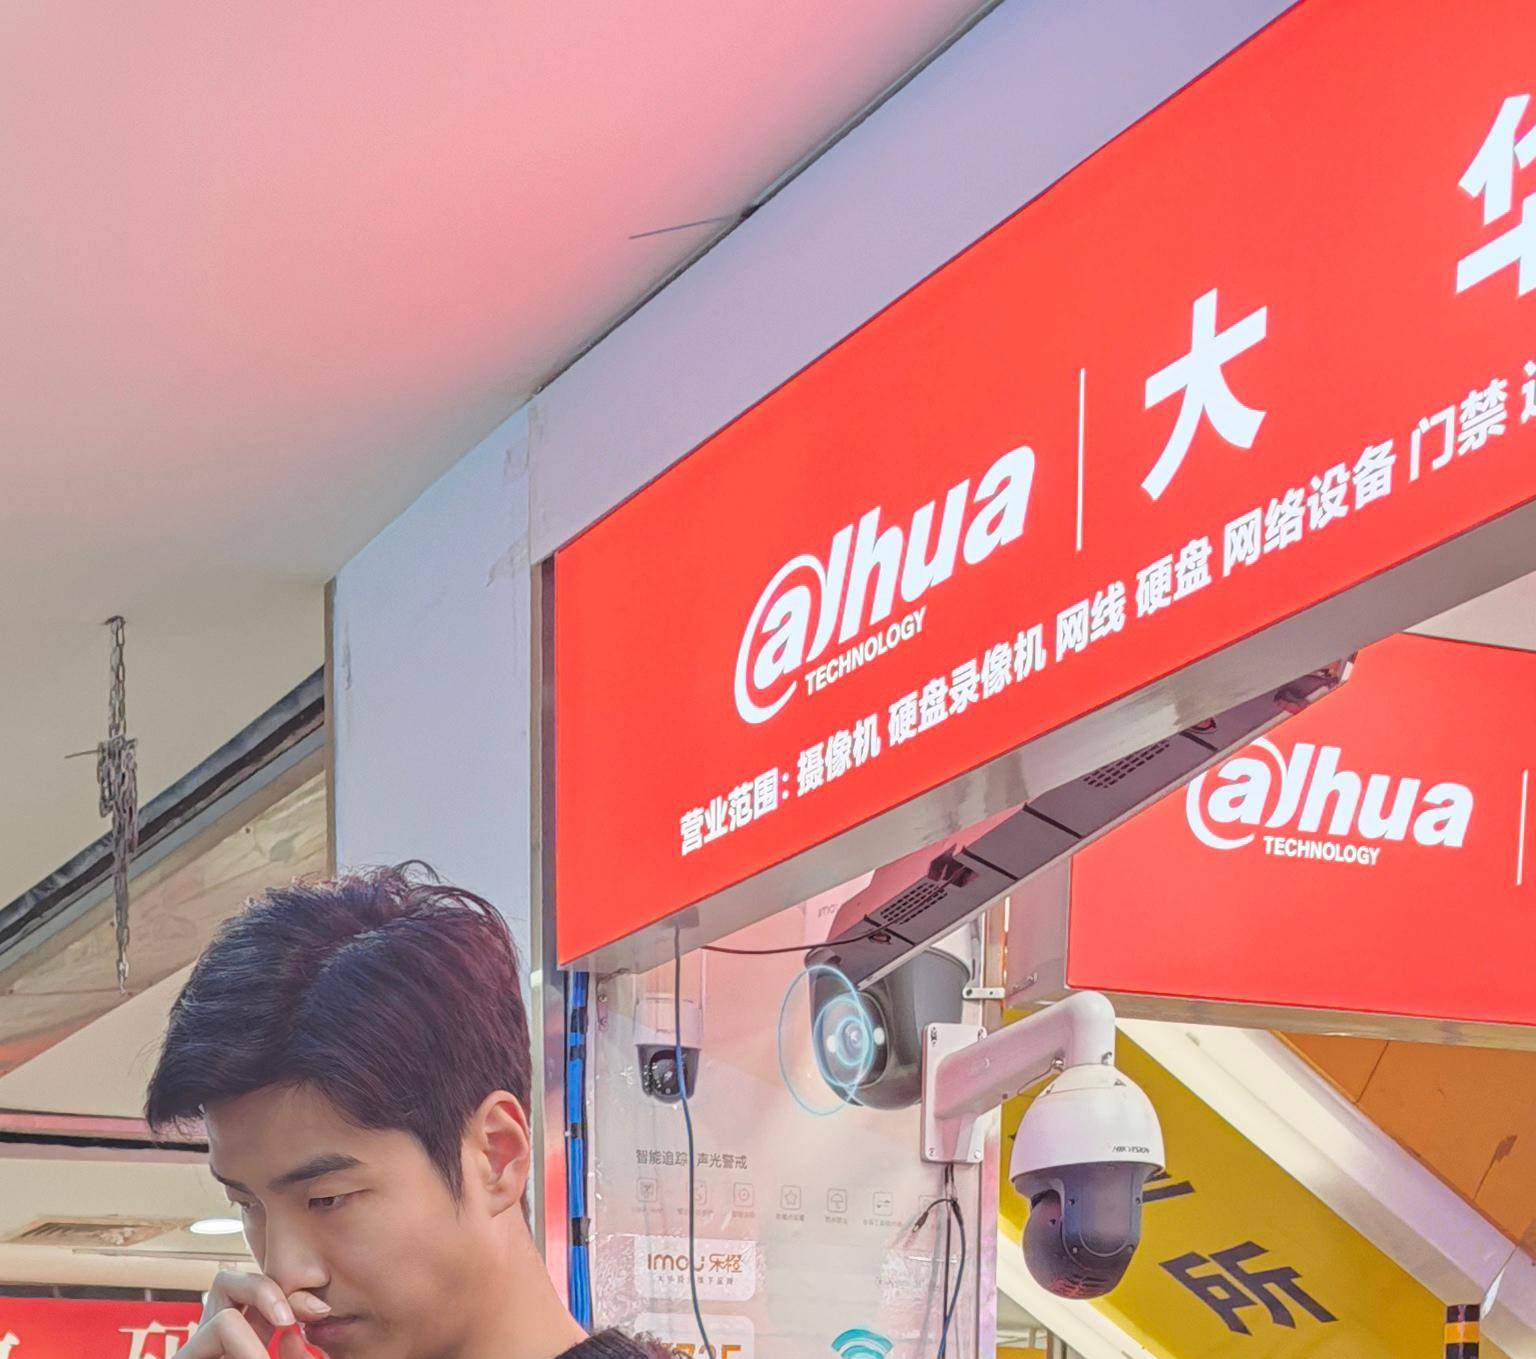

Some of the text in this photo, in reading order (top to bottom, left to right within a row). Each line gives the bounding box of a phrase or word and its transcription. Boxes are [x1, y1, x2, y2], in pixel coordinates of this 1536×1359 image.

[797, 714, 881, 797] 摄像机
[888, 624, 1046, 748] 硬盘录像机
[1056, 580, 1126, 662] 网线
[1136, 536, 1212, 619] 硬盘
[1223, 439, 1396, 577] 网络设备
[1409, 378, 1509, 482] 门禁
[805, 606, 927, 697] TECHNOLOGY
[1263, 835, 1380, 865] TECHNOLOGY
[636, 1149, 748, 1170] 智能追踪 声光警戒
[709, 1253, 744, 1274] 乐橙
